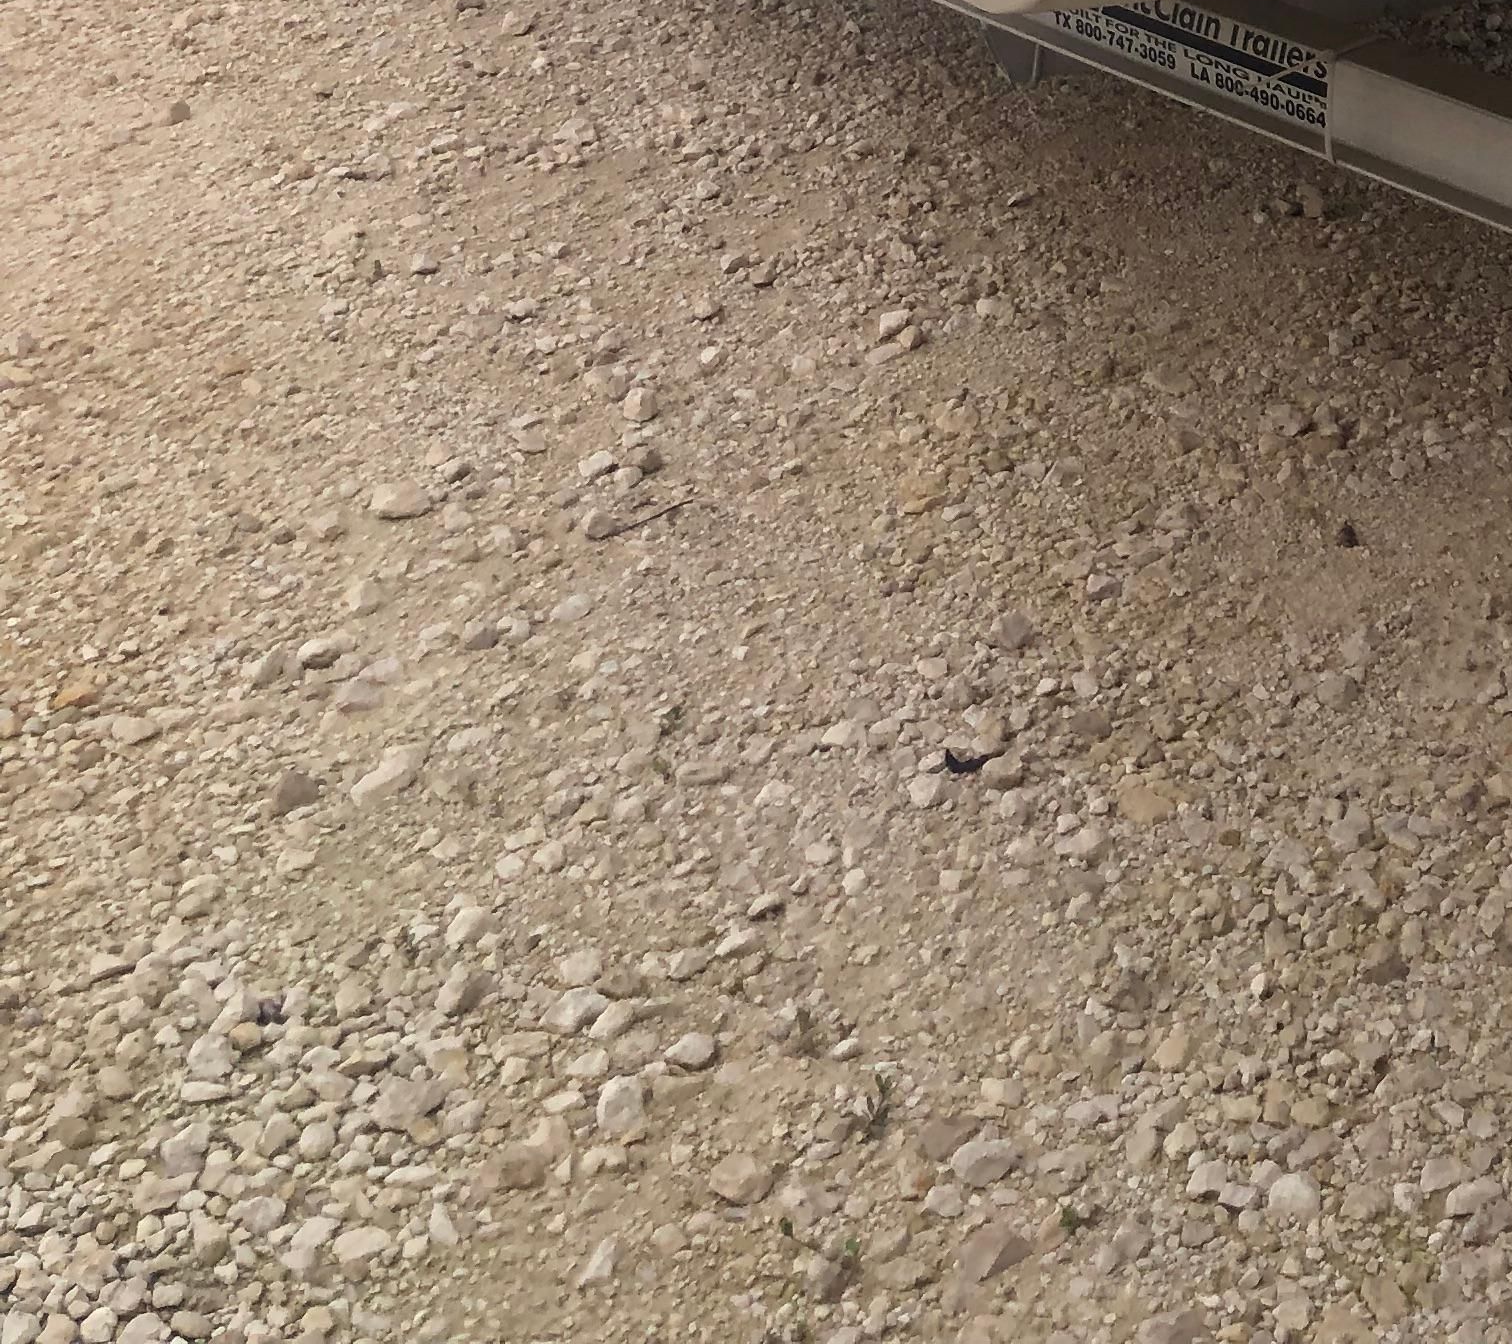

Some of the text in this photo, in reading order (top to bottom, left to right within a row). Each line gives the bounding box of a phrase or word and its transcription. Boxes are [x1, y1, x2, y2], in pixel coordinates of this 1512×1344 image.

[1053, 10, 1327, 129] TX 800-747-3059 LA 800-490-0664
[1105, 18, 1140, 40] FOR
[1144, 33, 1177, 53] THE
[1184, 49, 1250, 82] LONG
